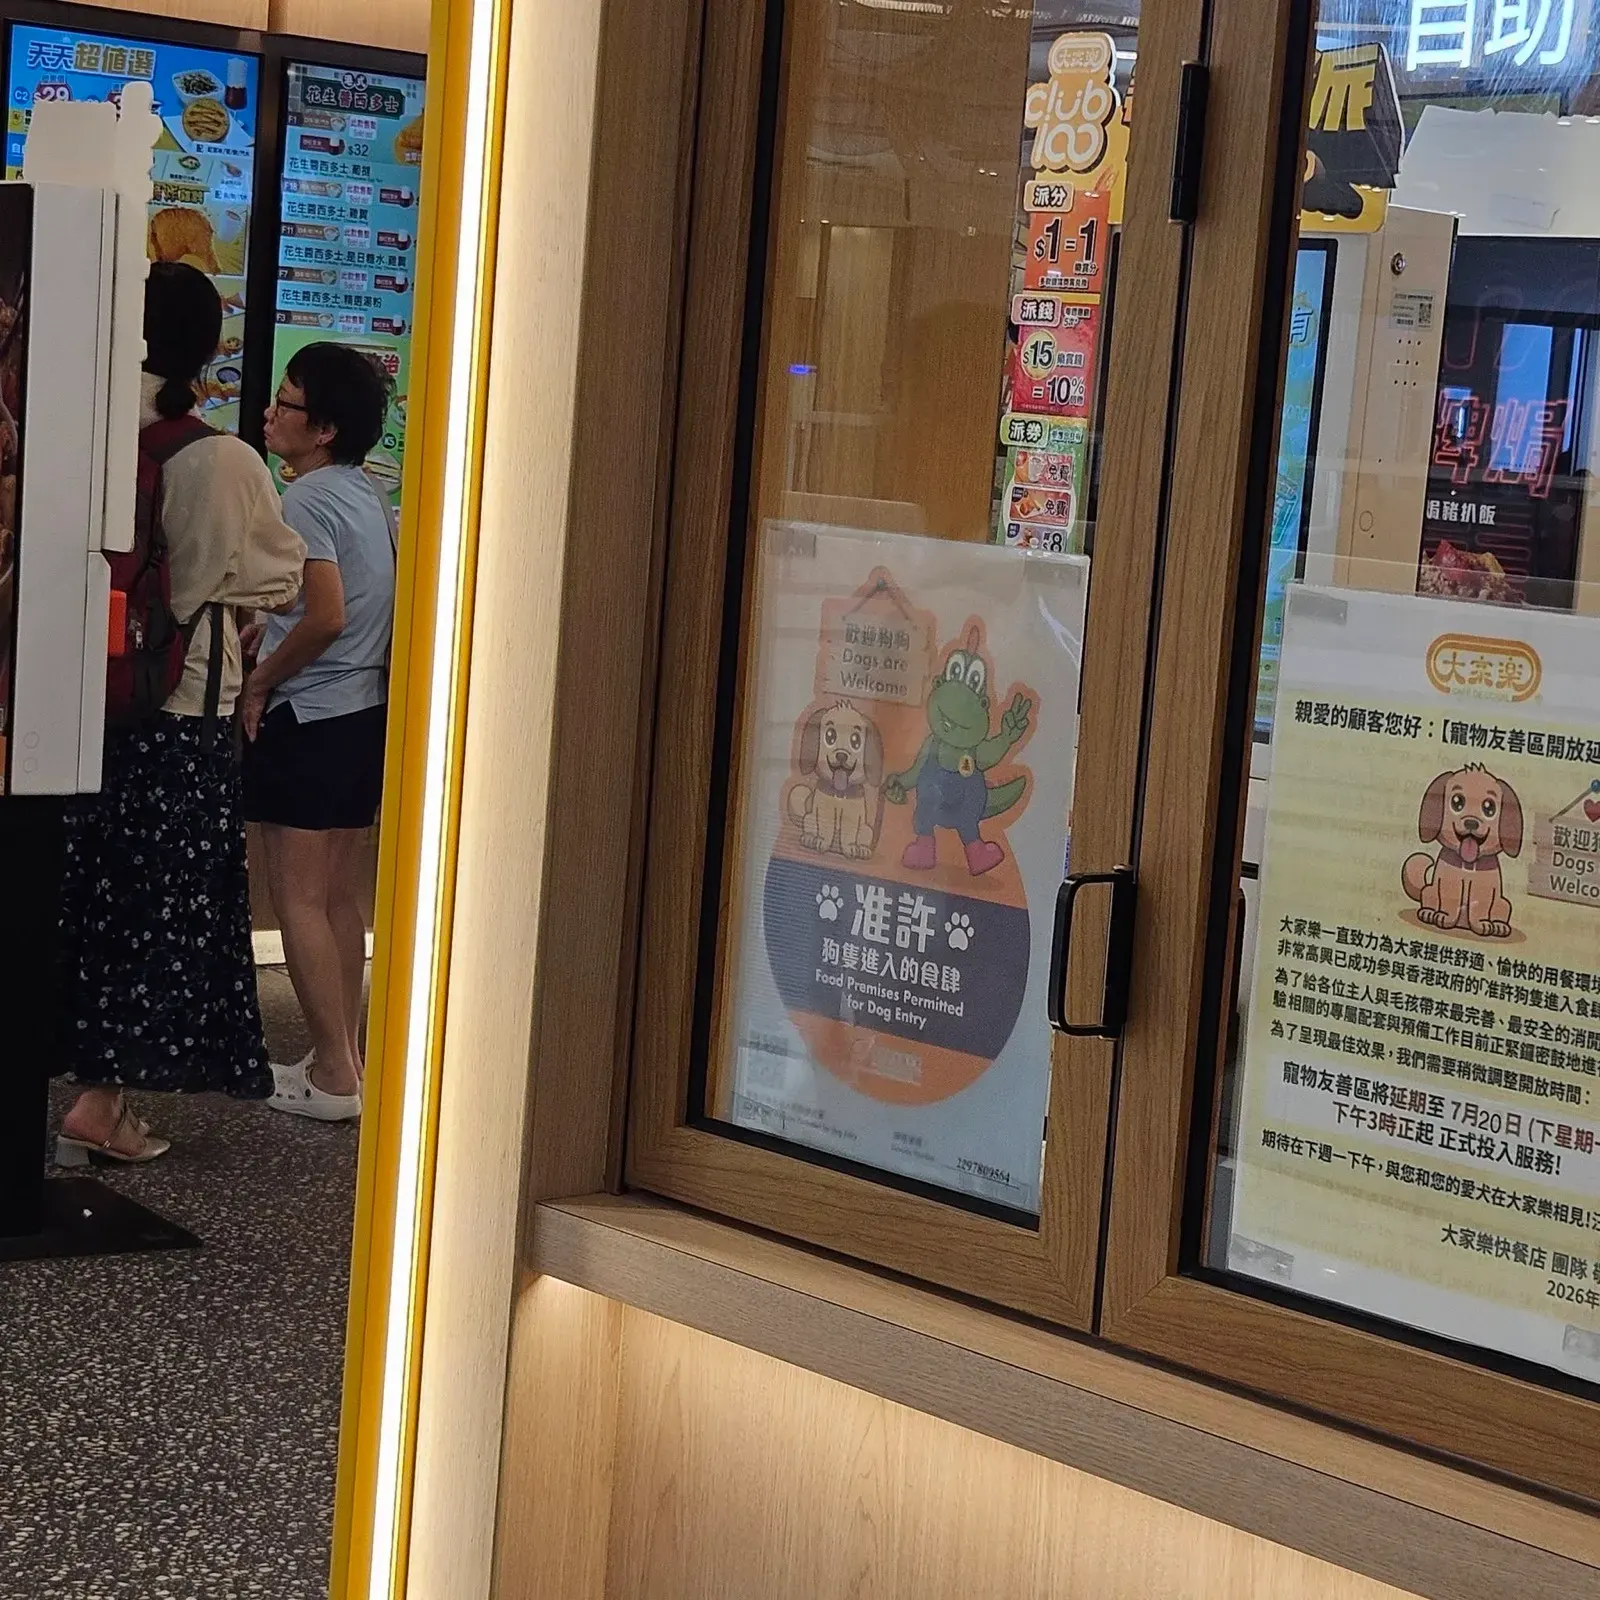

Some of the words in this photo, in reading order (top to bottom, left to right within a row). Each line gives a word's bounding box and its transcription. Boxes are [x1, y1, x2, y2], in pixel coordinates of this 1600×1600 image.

[28, 40, 156, 79] 天天超值選
[1027, 79, 1106, 121] club
[348, 143, 369, 157] $32
[1034, 185, 1067, 207] 派分
[1021, 299, 1055, 321] 派錢
[1022, 340, 1055, 367] $15
[1010, 420, 1042, 442] 派券
[1048, 464, 1070, 482] 免費
[1045, 499, 1067, 516] 免費
[842, 647, 878, 671] Dogs
[884, 656, 909, 672] are
[840, 671, 908, 697] Welcome
[1552, 852, 1595, 876] Dogs
[1550, 875, 1600, 898] Welco
[850, 883, 937, 953] 准許
[821, 936, 962, 994] 狗隻進入的食肆
[815, 968, 844, 989] Food
[847, 976, 900, 1002] Premises
[903, 989, 964, 1017] Permitted
[846, 994, 865, 1012] for
[867, 1000, 892, 1022] Dog
[895, 1008, 928, 1030] Entry
[1272, 989, 1600, 1077] 驗相關的專屬配套與預備工作目前正緊鑼密鼓地進
[1546, 1279, 1600, 1310] 2026年
